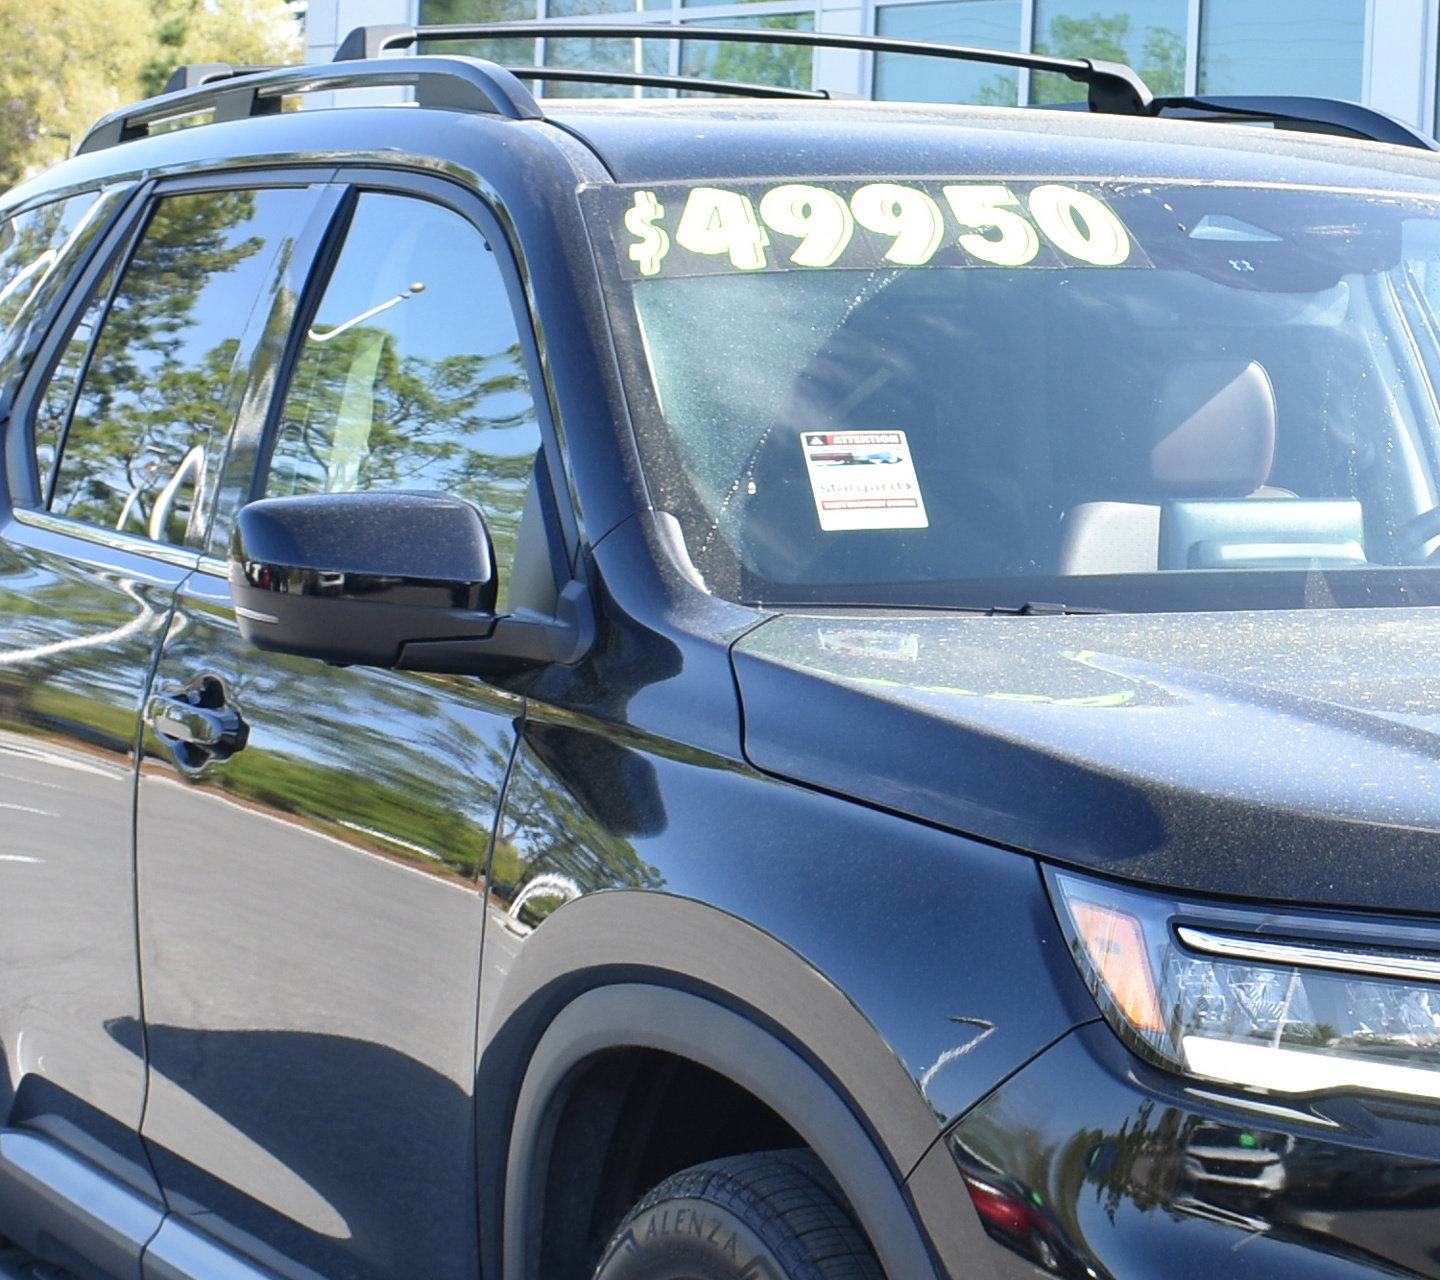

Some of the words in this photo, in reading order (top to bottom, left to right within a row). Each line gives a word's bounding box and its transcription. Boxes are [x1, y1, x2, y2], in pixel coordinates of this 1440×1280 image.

[624, 182, 1131, 277] $49950
[832, 434, 900, 445] ATTENTION
[645, 1207, 738, 1260] ALENZA
